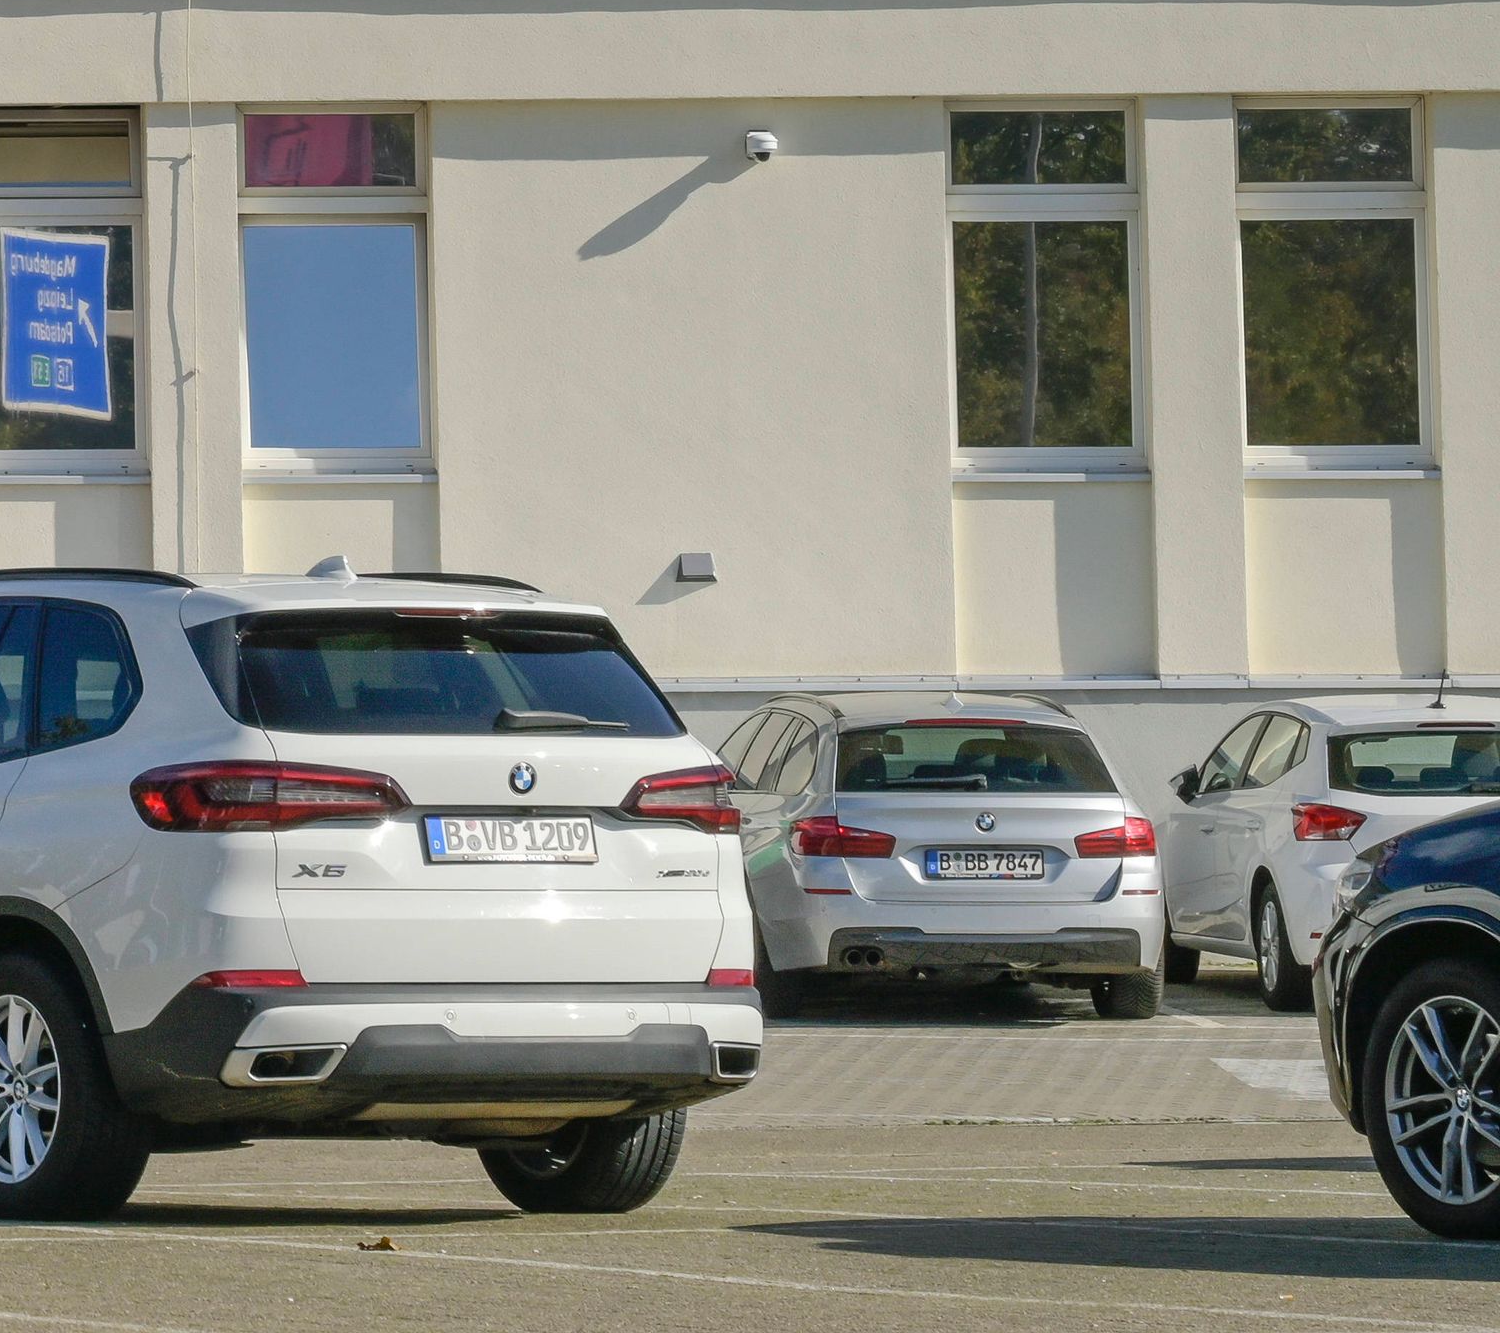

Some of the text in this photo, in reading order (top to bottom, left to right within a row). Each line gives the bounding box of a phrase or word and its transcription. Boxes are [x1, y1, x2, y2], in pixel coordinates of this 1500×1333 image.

[444, 821, 464, 851] B
[480, 820, 518, 851] VB
[523, 822, 590, 851] 1209
[940, 853, 951, 871] B
[965, 853, 988, 871] BB
[993, 853, 1040, 871] 7847
